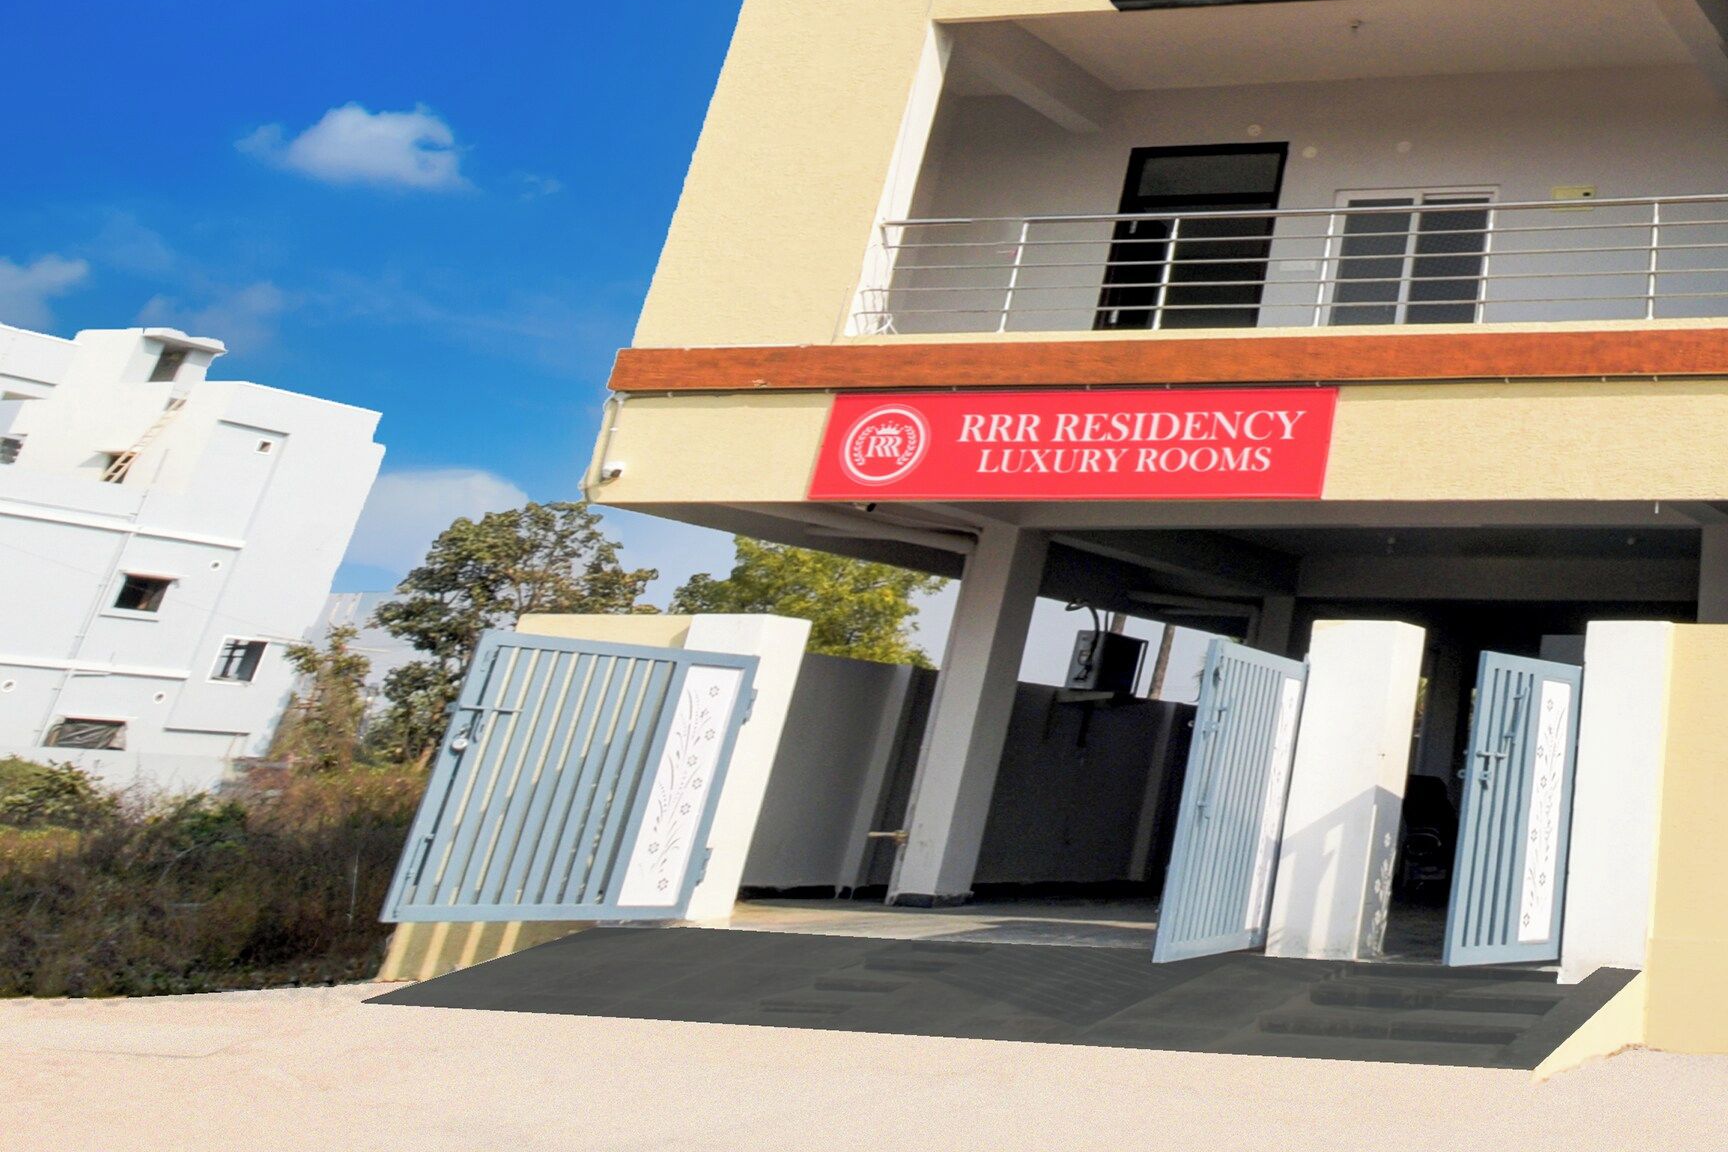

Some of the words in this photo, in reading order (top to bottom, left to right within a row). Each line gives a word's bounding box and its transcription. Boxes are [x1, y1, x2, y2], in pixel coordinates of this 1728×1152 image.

[956, 413, 1041, 443] RRR
[1050, 410, 1307, 443] RESIDENCY
[976, 448, 1129, 474] LUXURY
[1134, 446, 1272, 473] ROOMS
